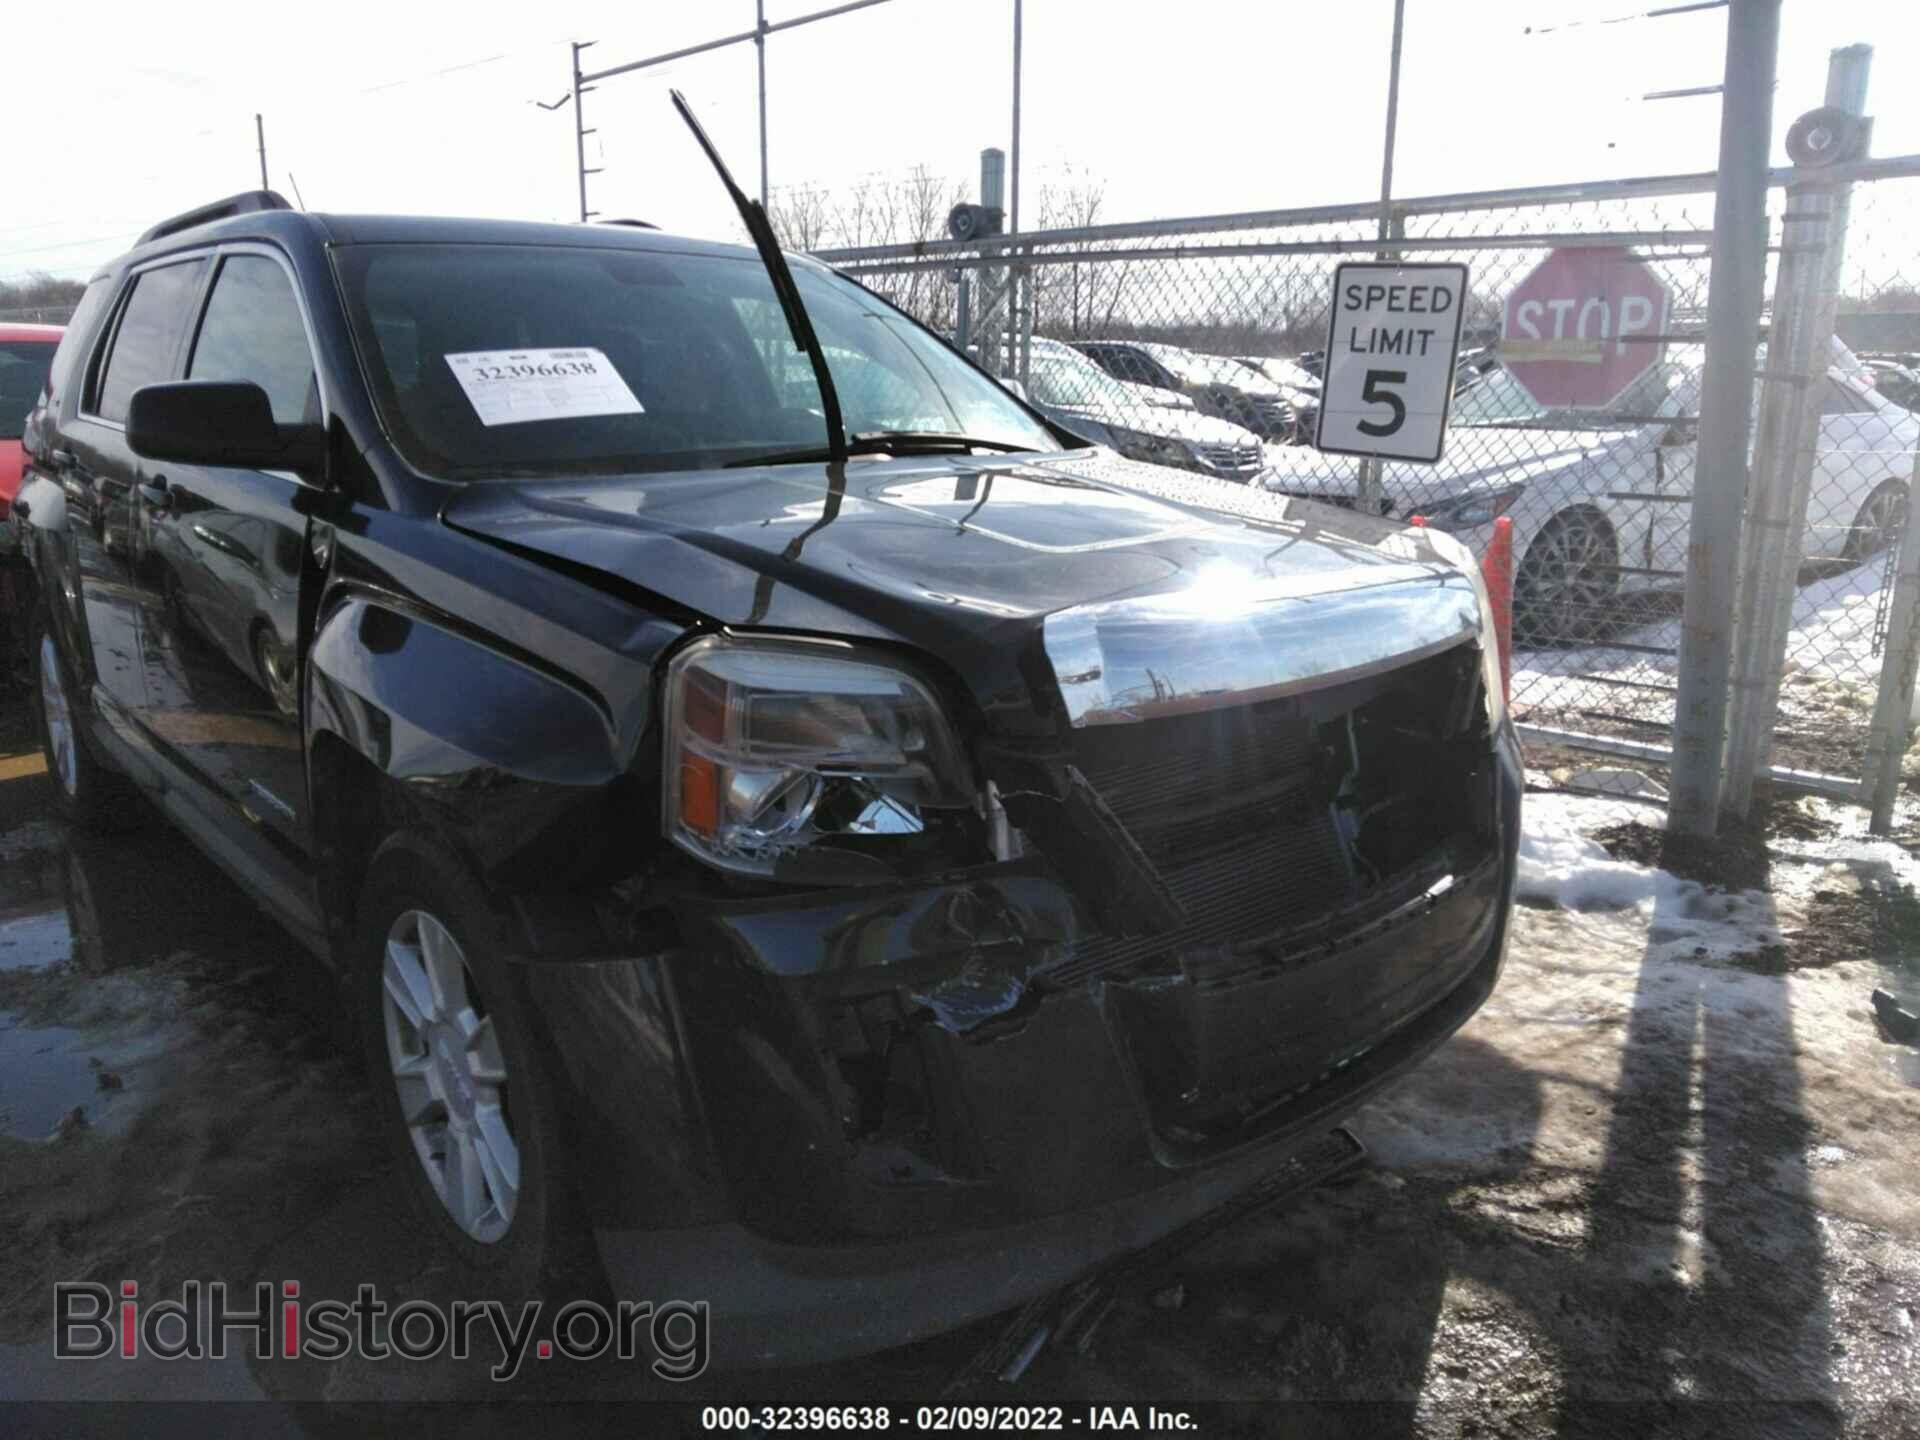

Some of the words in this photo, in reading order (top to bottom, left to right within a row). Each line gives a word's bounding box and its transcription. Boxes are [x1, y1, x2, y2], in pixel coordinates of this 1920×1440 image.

[1344, 284, 1453, 313] SPEED
[1350, 326, 1435, 356] LIMIT
[1516, 296, 1653, 356] STOP
[473, 362, 597, 381] 32396638
[1356, 369, 1407, 437] 5
